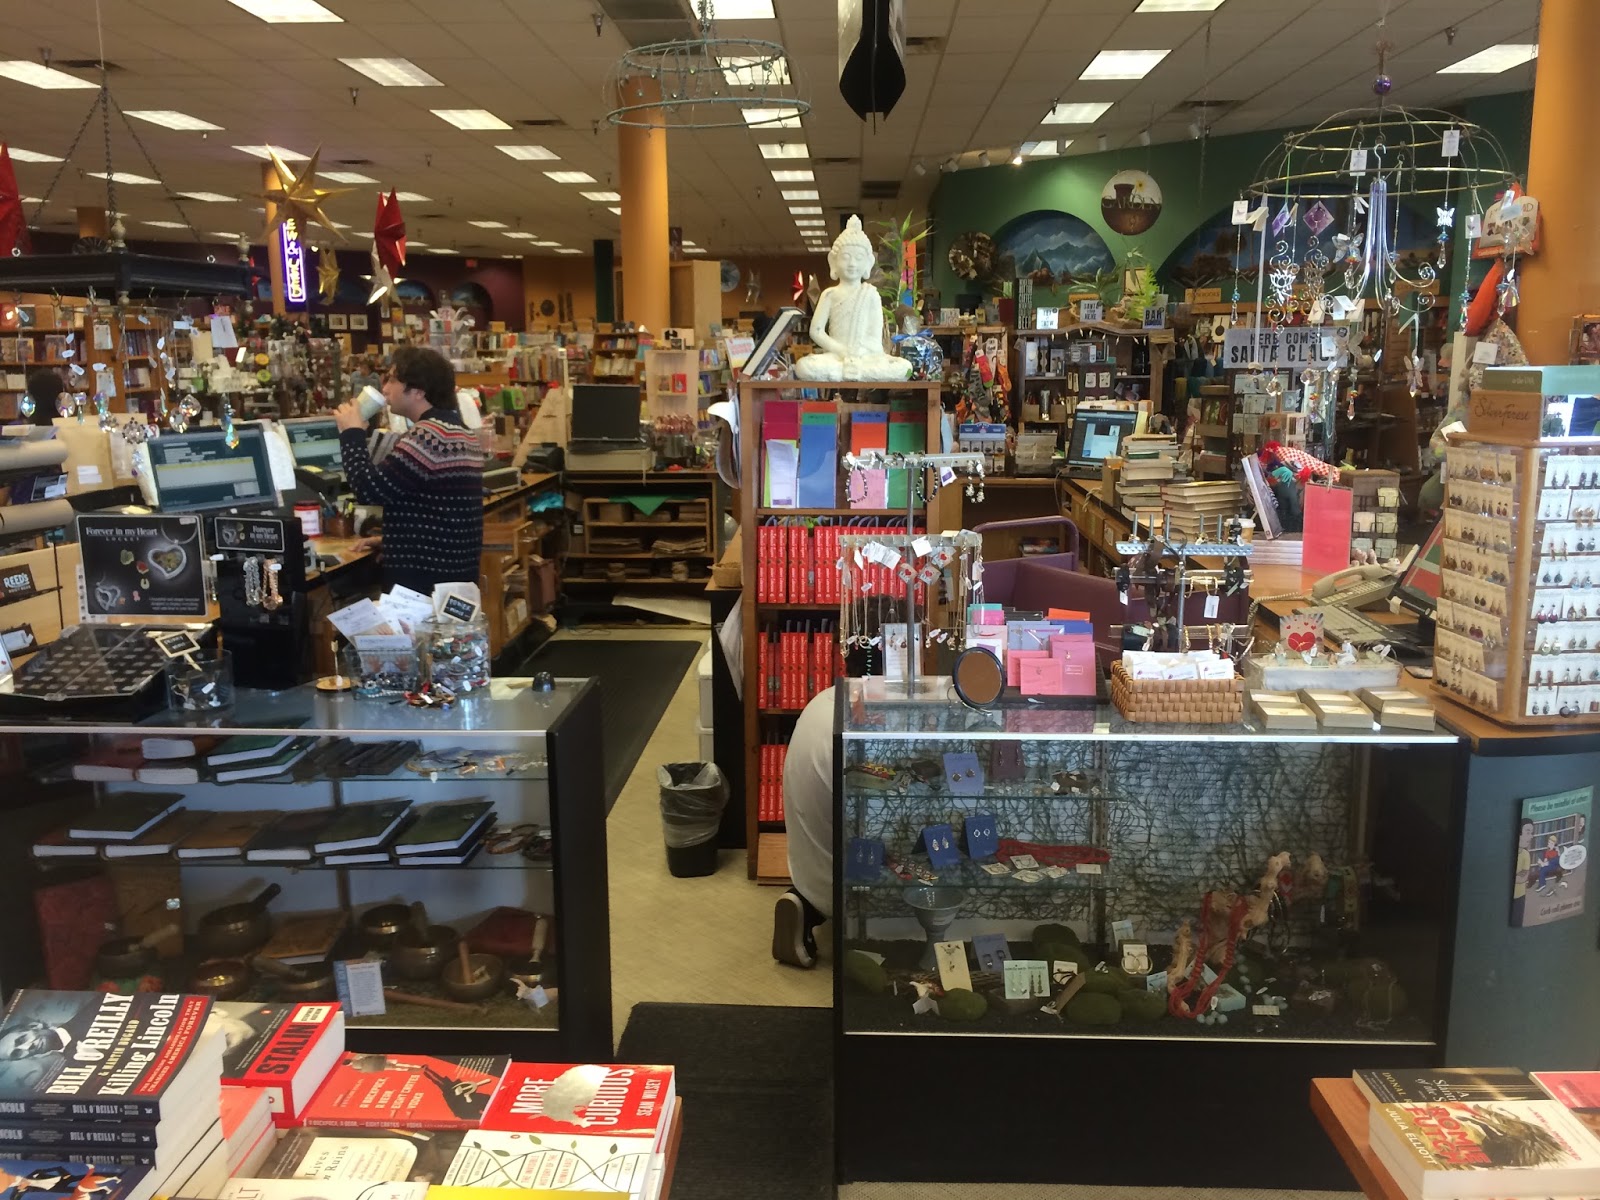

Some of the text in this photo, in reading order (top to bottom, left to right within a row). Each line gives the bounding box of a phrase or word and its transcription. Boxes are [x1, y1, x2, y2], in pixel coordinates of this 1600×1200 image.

[287, 241, 299, 255] &
[287, 257, 302, 298] USED
[1250, 333, 1279, 345] HERE
[86, 527, 158, 538] Forever in my Heart
[252, 525, 275, 534] Forever
[184, 1000, 194, 1015] THAT
[45, 1064, 97, 1094] BILL
[73, 992, 134, 1061] O'REILLY
[97, 994, 180, 1096] Killing Lincoln
[102, 1047, 126, 1074] MARTIN
[117, 1019, 140, 1046] DUGARD
[147, 1001, 202, 1091] CHANGED AMERICA FOREVER
[255, 1024, 320, 1074] STALIN
[510, 1068, 636, 1126] MORE CURIOUS
[636, 1078, 662, 1117] SEAN WILSEY
[1381, 1072, 1407, 1096] DONAL
[1433, 1079, 1458, 1101] Slanti
[72, 1104, 87, 1113] BILL
[89, 1104, 118, 1114] O'REILLY
[70, 1131, 85, 1140] BILL
[86, 1132, 115, 1141] O'REILLY
[1385, 1108, 1409, 1132] JULIA
[1405, 1132, 1438, 1165] ELLIOTT
[1404, 1106, 1464, 1164] FUTCH
[1427, 1106, 1492, 1164] ROMIE
[305, 1151, 329, 1177] Lives
[325, 1145, 349, 1171] Ruins
